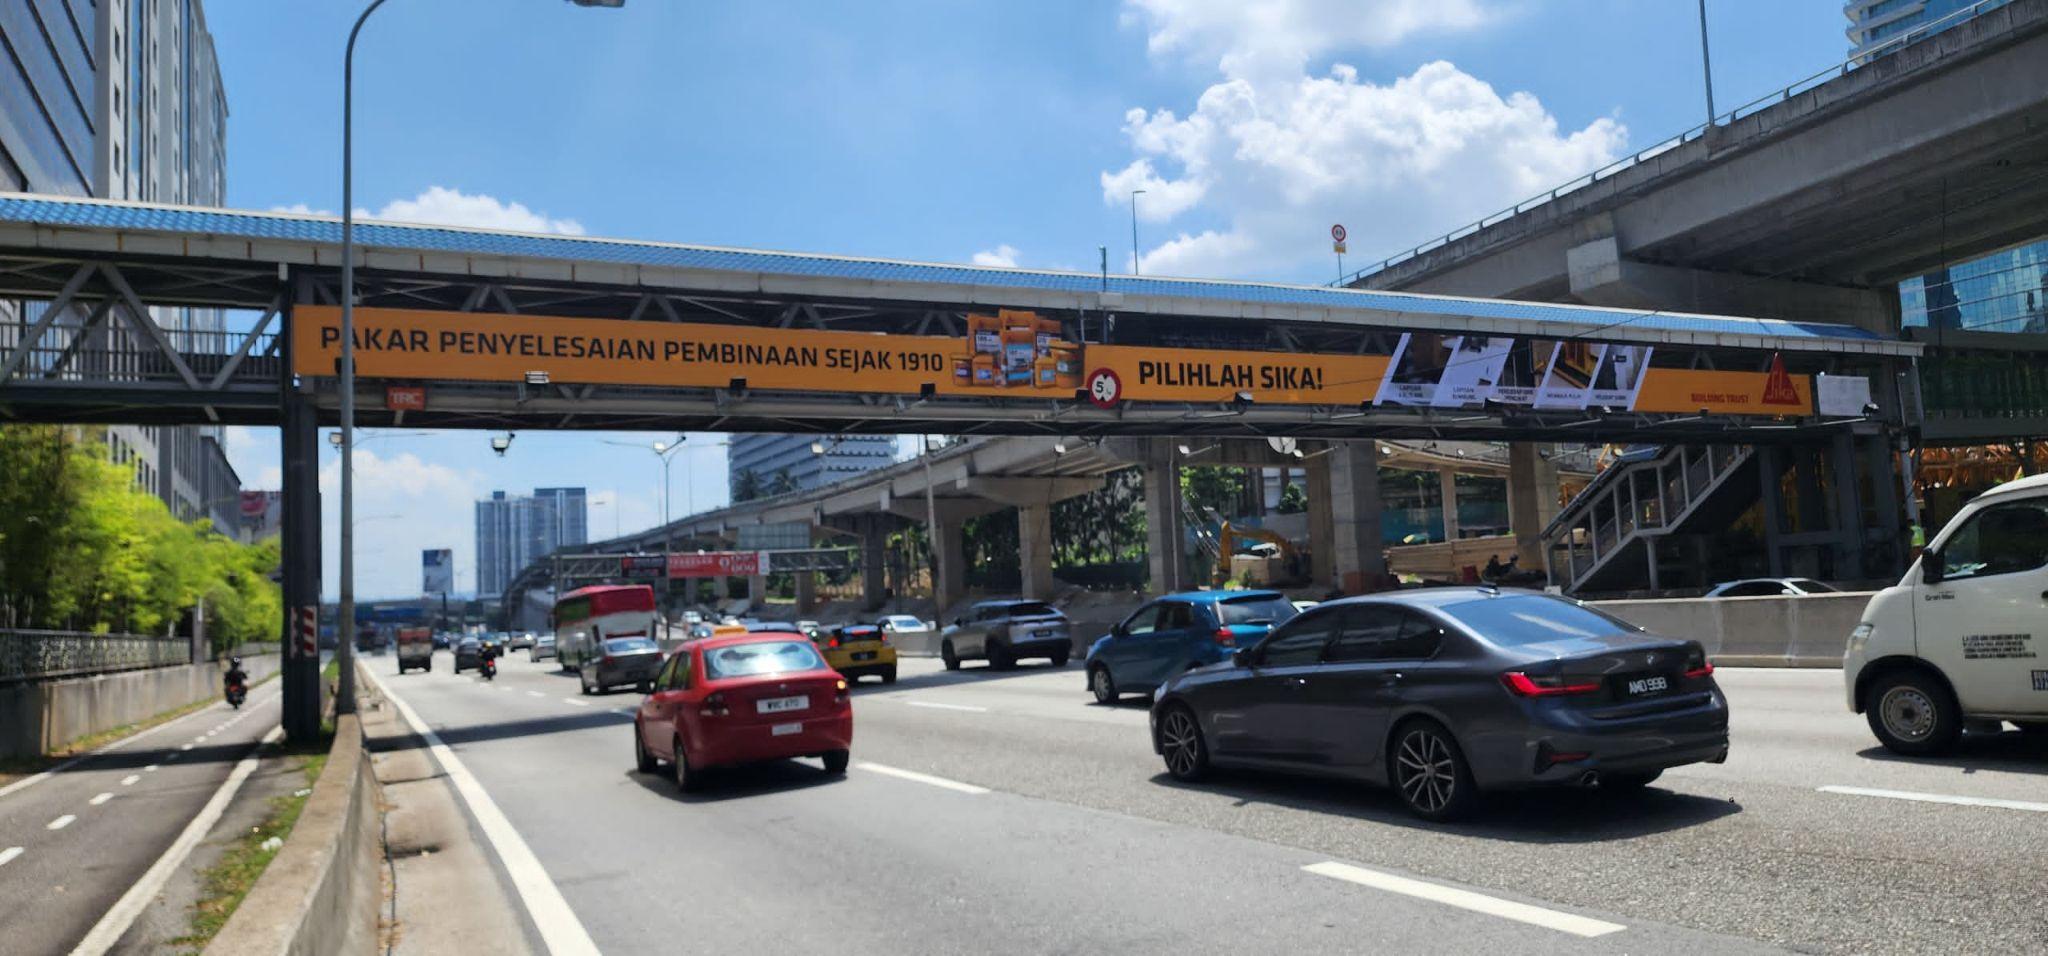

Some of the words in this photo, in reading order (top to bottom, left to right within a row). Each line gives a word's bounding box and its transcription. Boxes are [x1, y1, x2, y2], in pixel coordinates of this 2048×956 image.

[440, 331, 656, 361] PENYELESAIAN
[664, 341, 818, 367] PEMBINAAN
[826, 348, 892, 373] SEJAK
[898, 352, 943, 372] 1910
[1138, 361, 1253, 389] PILIHLAH
[1260, 365, 1323, 391] SIKA!
[392, 391, 421, 405] TRC
[1726, 393, 1749, 405] TRUST
